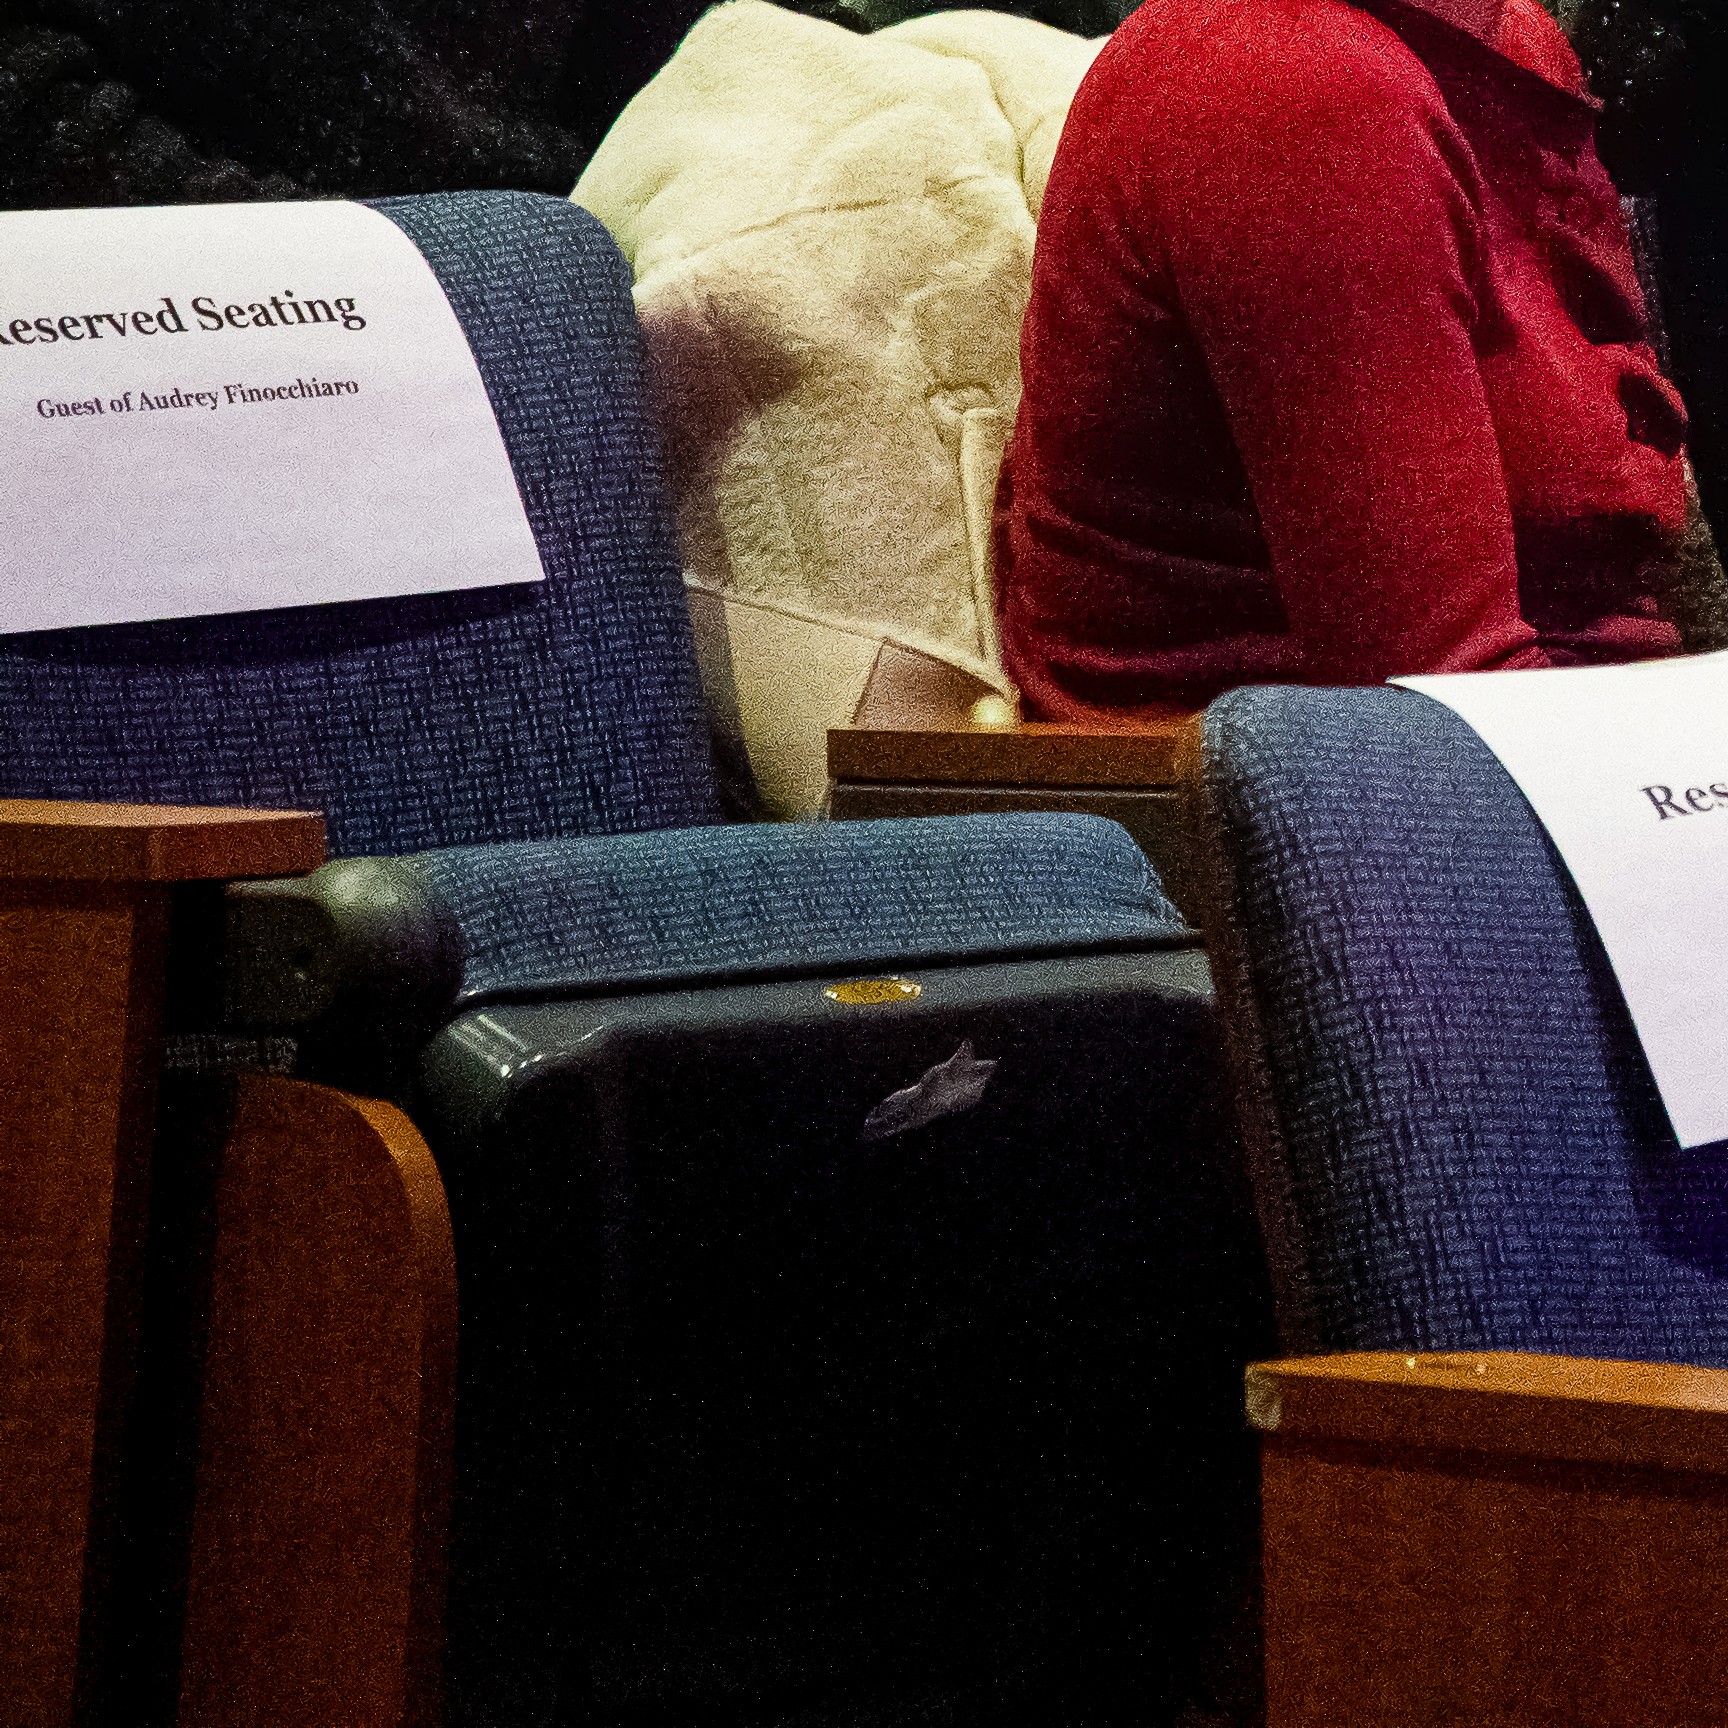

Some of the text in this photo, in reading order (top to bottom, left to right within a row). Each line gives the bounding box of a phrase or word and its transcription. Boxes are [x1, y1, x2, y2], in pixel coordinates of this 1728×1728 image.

[0, 290, 367, 346] eserved Seating
[36, 377, 360, 420] Guest of Audrey Finocchiaro
